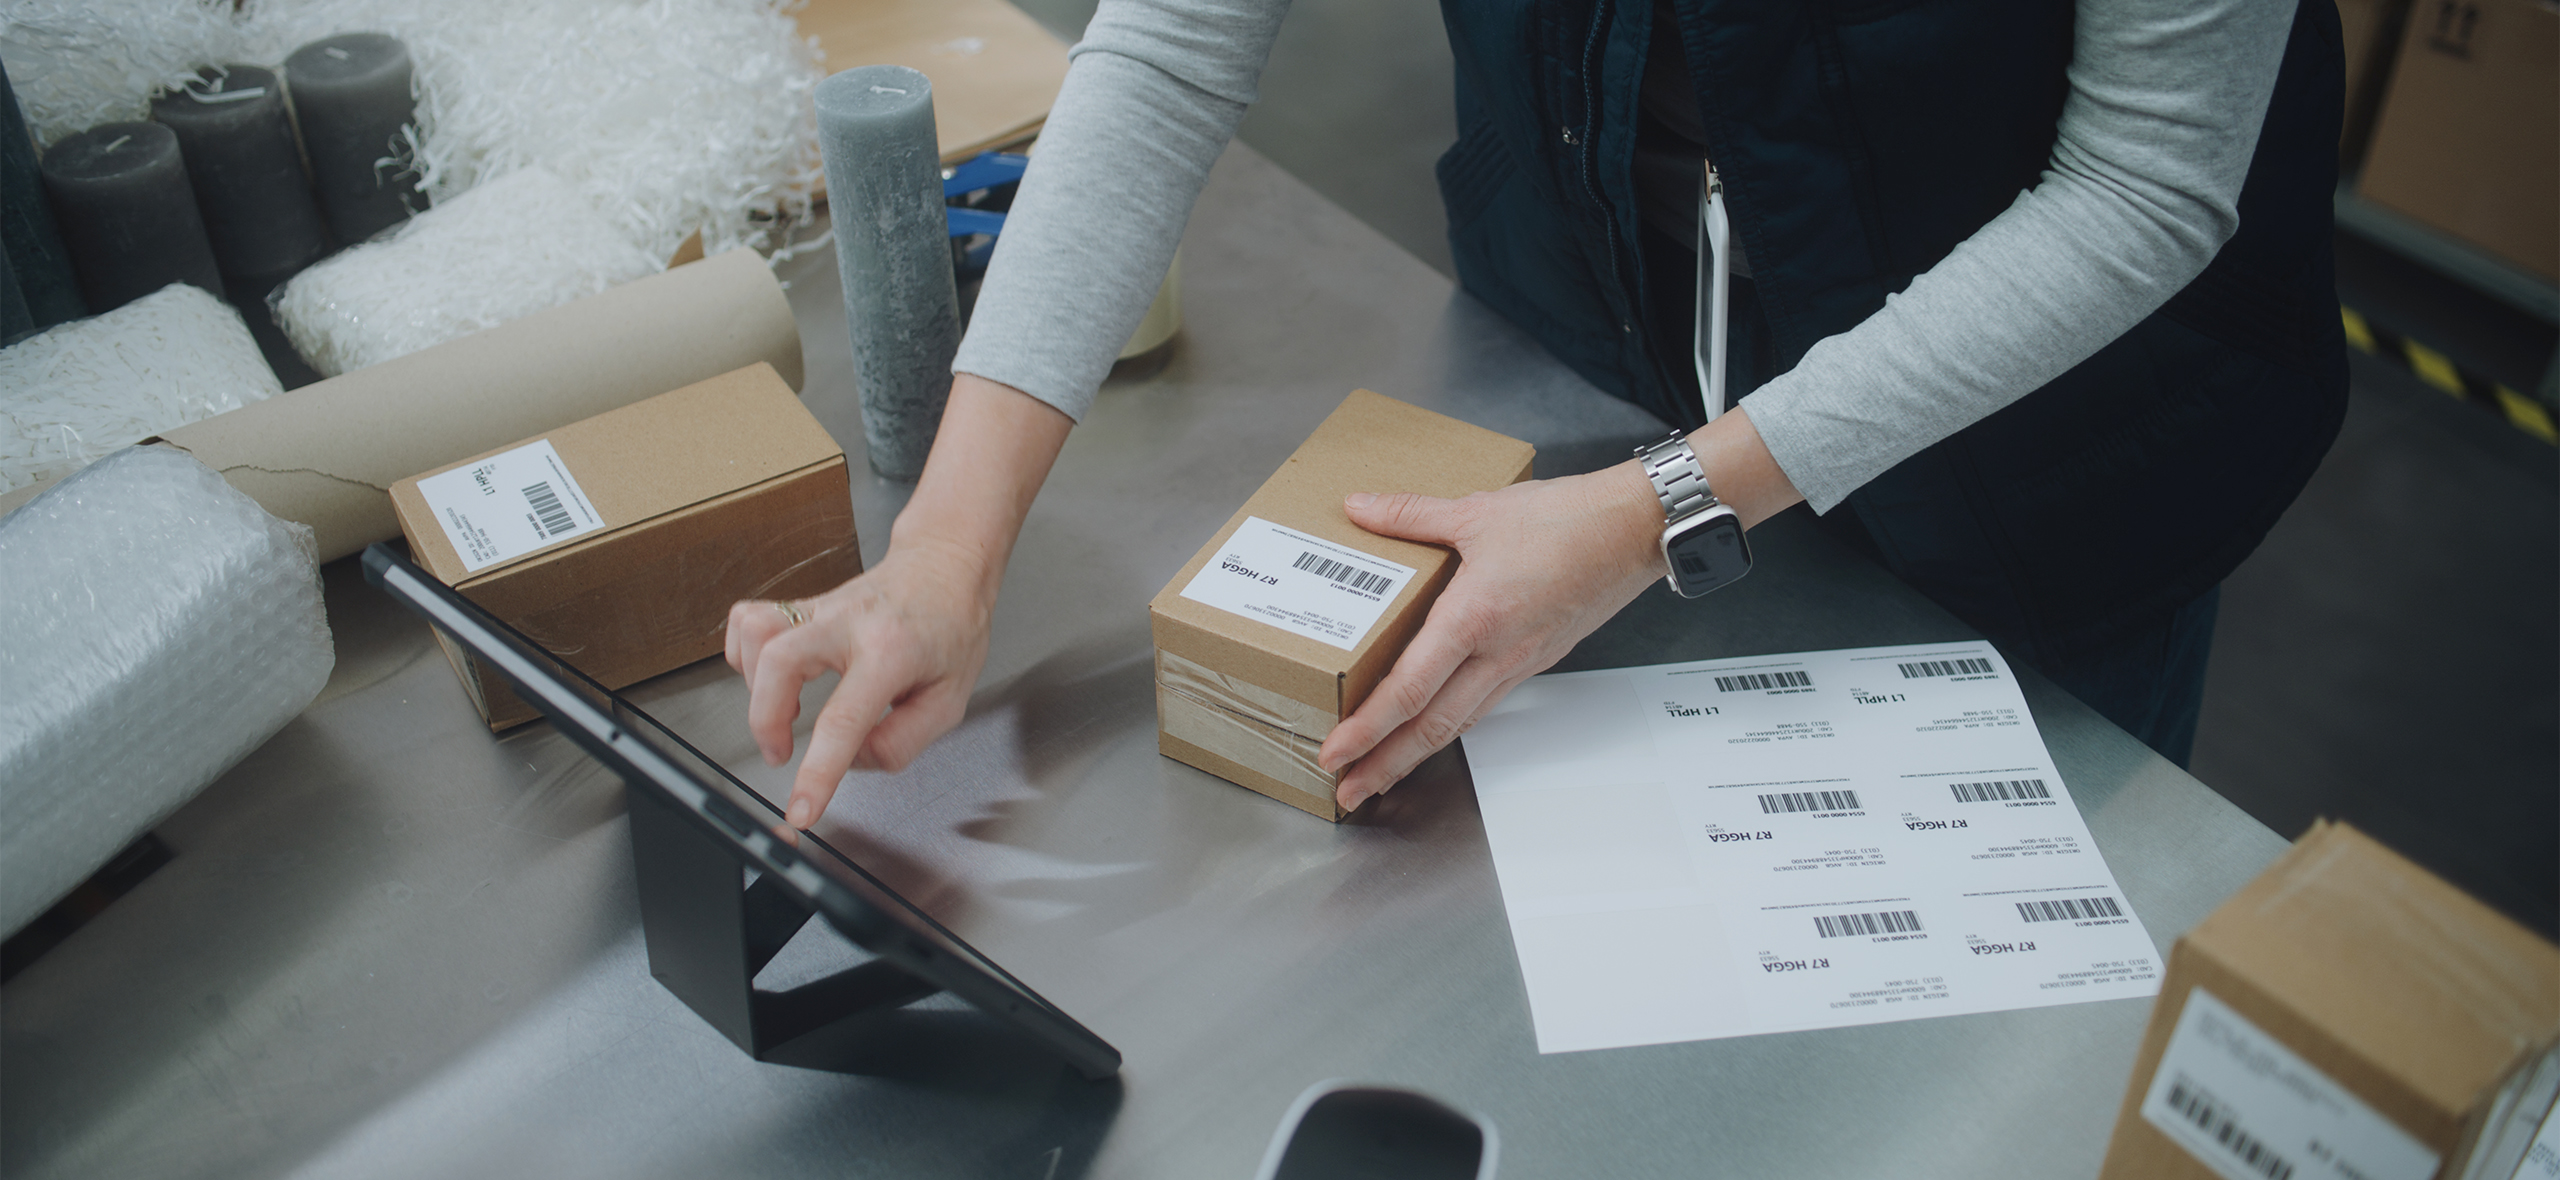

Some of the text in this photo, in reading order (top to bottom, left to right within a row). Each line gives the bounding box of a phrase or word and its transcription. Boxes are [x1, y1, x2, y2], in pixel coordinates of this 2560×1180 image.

[471, 467, 490, 486] HPLL
[482, 485, 496, 496] L1
[1220, 561, 1279, 586] R7 HGGA
[1329, 582, 1381, 602] 6554 0000 0013
[1336, 620, 1356, 630] (013)
[1853, 693, 1906, 704] L1 HPLL
[1666, 706, 1720, 717] L1 HPLL
[1905, 819, 1968, 831] R7 HGGA
[1708, 830, 1773, 843] R7 HGGA
[1969, 941, 2037, 955] R7 HGGA
[1762, 958, 1830, 973] R7 HGGA
[2127, 958, 2150, 966] (013)
[1921, 976, 1944, 984] (013)
